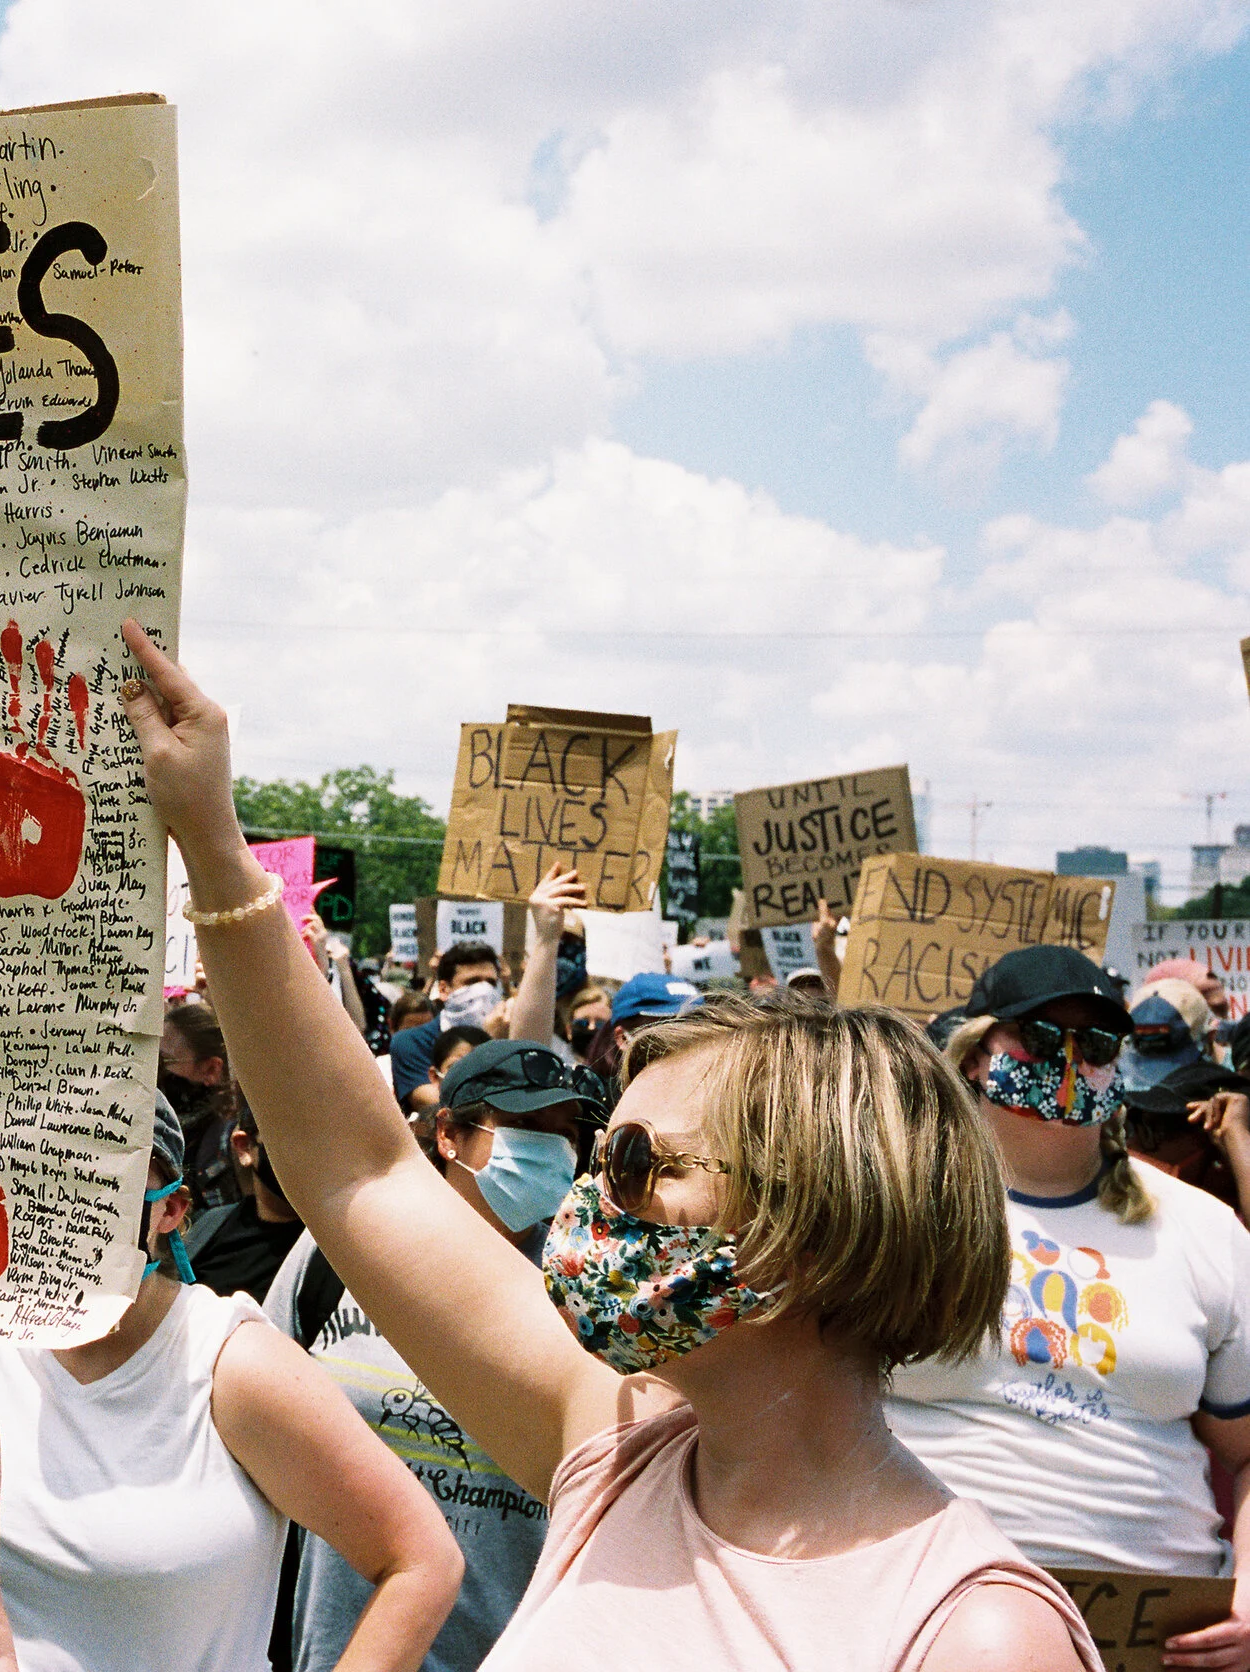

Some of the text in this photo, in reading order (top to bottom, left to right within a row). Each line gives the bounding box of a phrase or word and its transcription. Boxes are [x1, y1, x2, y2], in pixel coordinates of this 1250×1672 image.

[4, 501, 53, 522] Harris
[19, 551, 86, 578] Cedrick
[54, 582, 103, 615] Tyrell
[468, 728, 638, 806] BLACK
[766, 774, 874, 810] UNTIL
[499, 795, 607, 849] LIVES
[752, 797, 899, 857] JUSTICE
[752, 869, 861, 918] REALI
[857, 863, 953, 926] END
